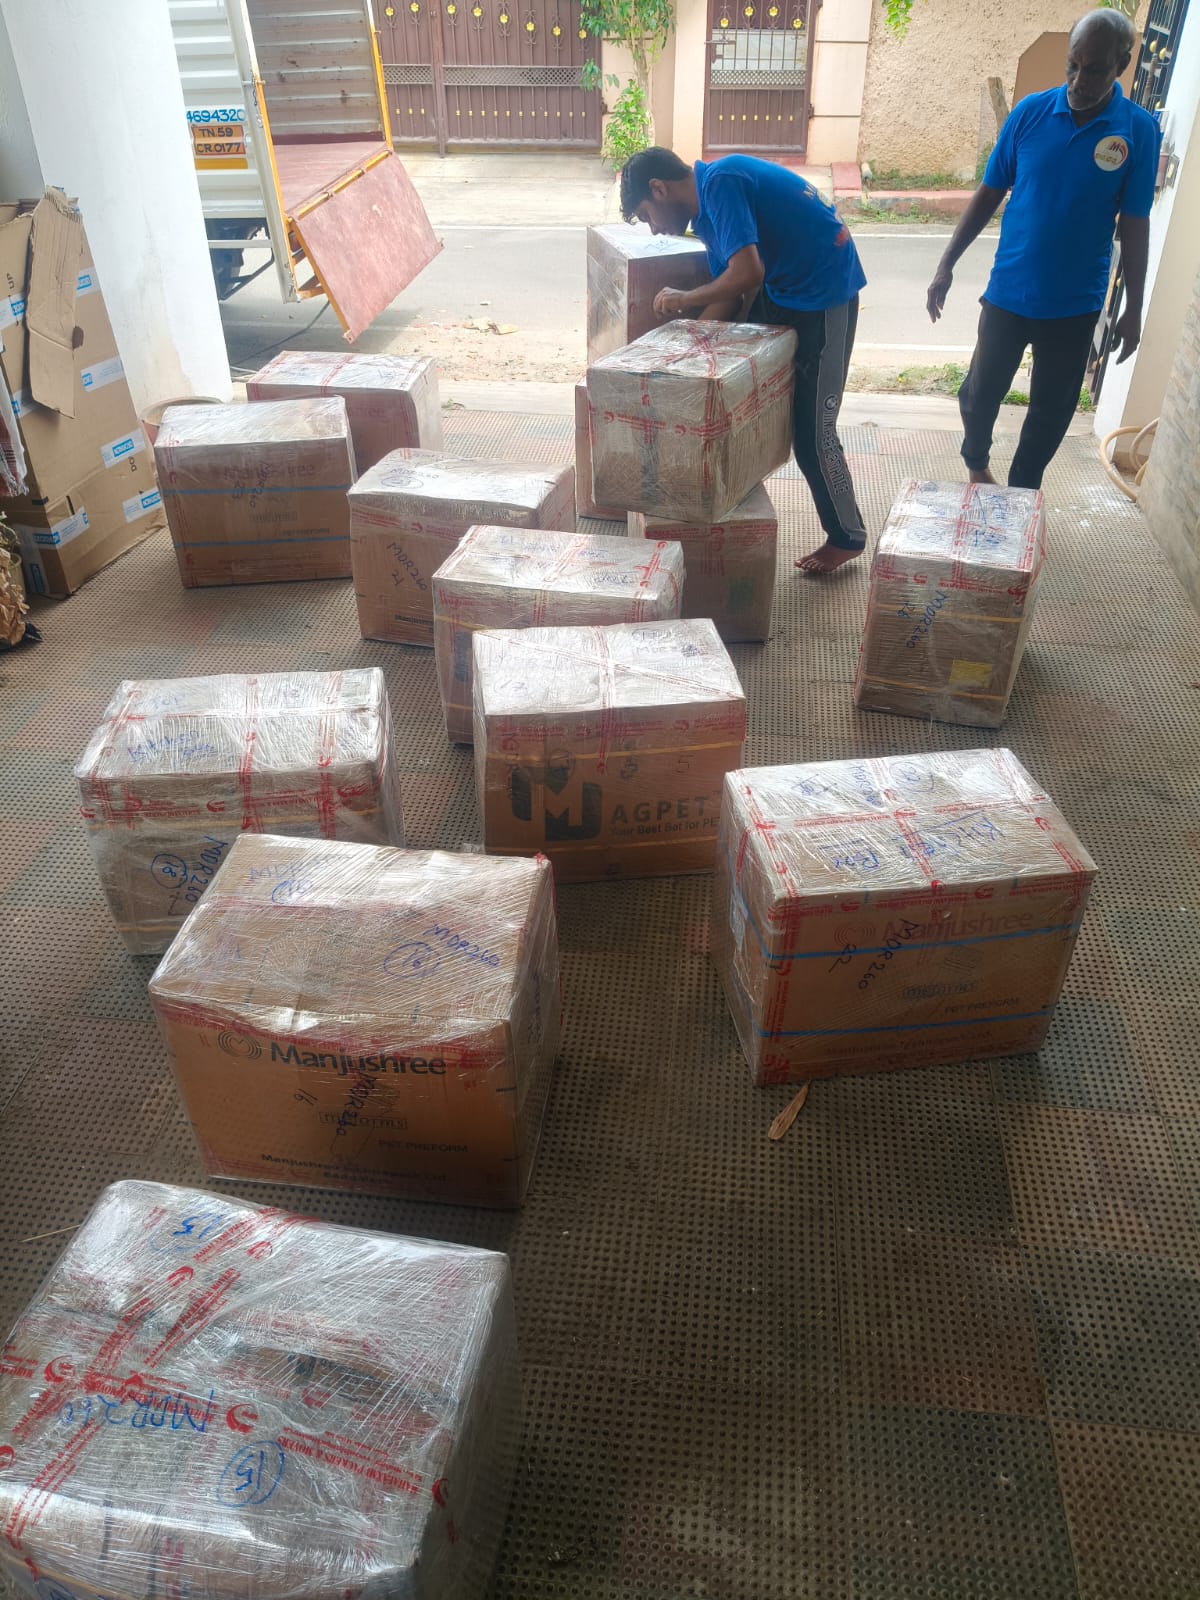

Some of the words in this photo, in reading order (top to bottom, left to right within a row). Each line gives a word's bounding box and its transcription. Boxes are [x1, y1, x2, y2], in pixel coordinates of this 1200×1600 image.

[386, 541, 428, 592] MDR260
[905, 590, 949, 649] MDR260
[184, 836, 228, 902] MDR260
[423, 923, 500, 968] MDR260
[857, 918, 920, 990] MDR260
[270, 1041, 447, 1075] Manjushree
